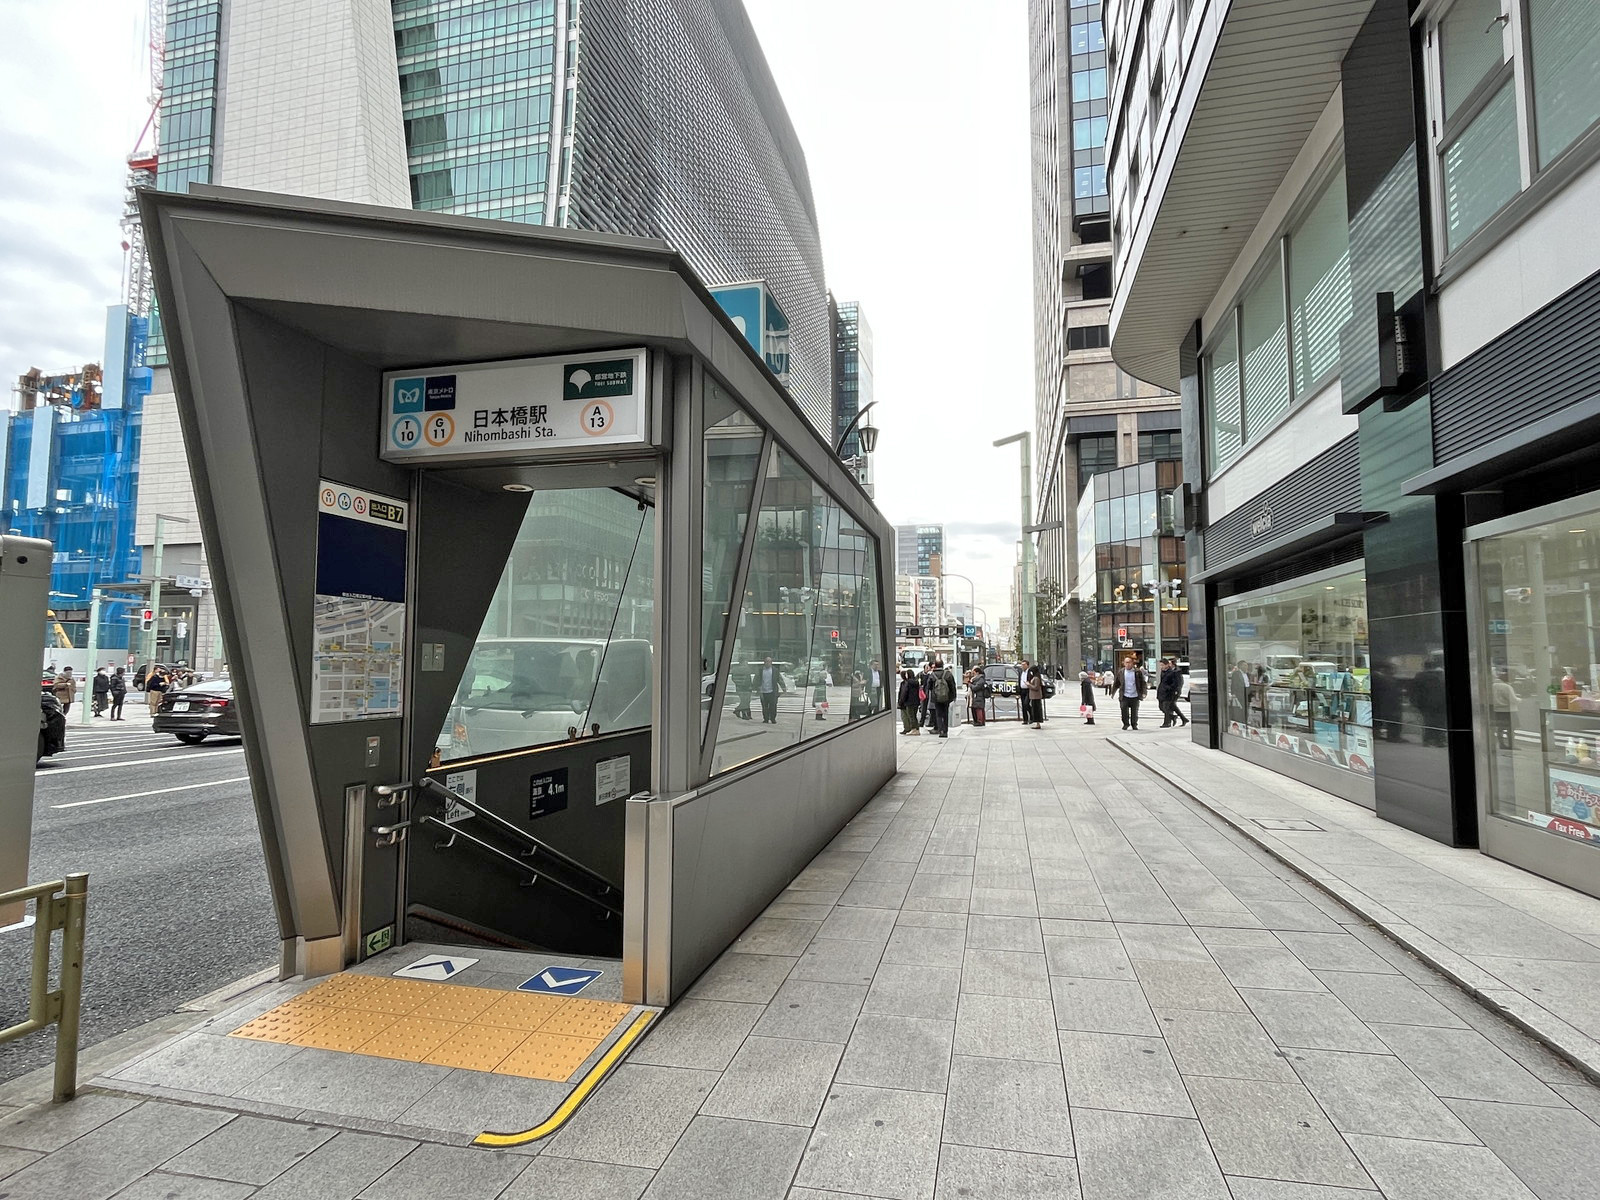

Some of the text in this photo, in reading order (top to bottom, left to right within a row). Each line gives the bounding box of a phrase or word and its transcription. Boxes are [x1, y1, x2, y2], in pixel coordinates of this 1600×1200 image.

[473, 404, 548, 429] 日本橋駅
[592, 406, 602, 416] A
[404, 420, 411, 430] T
[435, 417, 444, 428] G
[590, 416, 605, 428] 13
[401, 430, 414, 442] 10
[433, 428, 445, 439] 11
[464, 426, 557, 443] Nihombashi Sta.
[387, 505, 403, 522] B7
[992, 681, 1017, 693] S.RIDE
[547, 783, 565, 796] 4.1m
[1554, 820, 1586, 839] Tax Free
